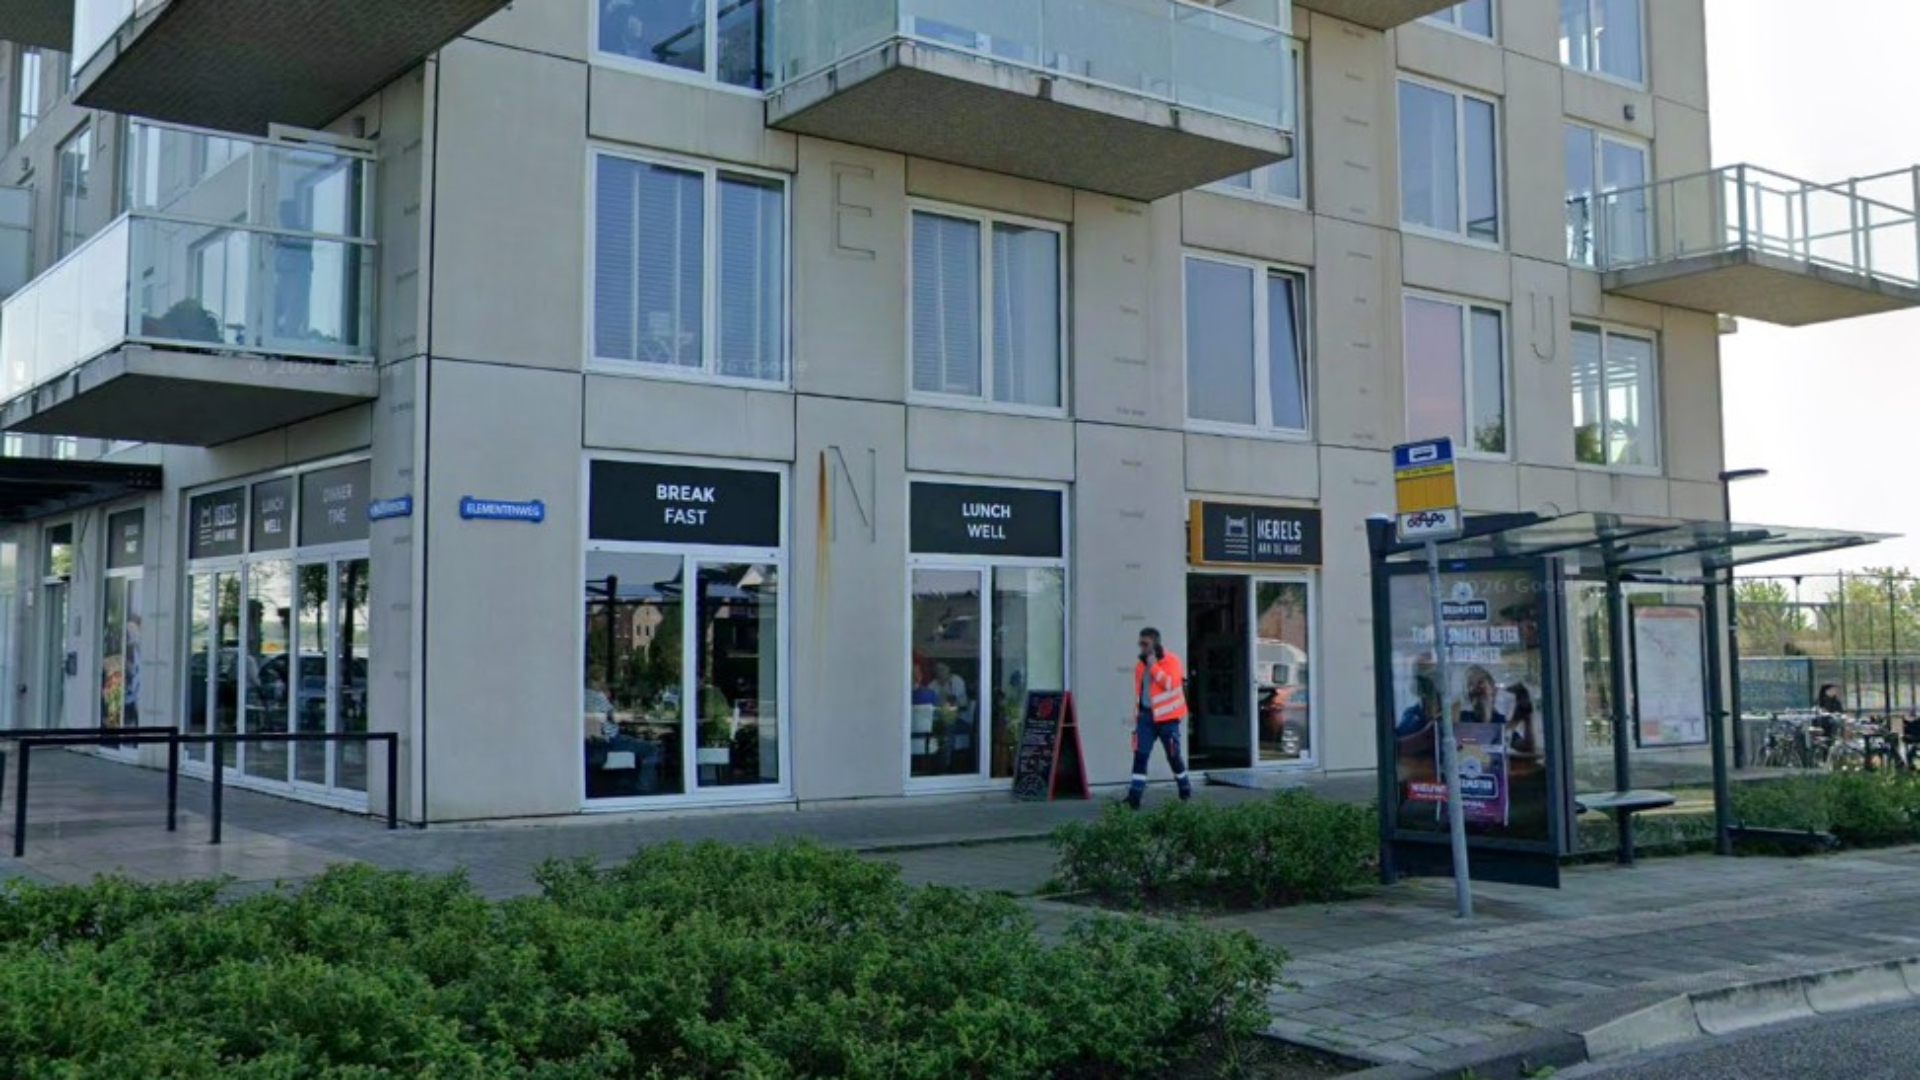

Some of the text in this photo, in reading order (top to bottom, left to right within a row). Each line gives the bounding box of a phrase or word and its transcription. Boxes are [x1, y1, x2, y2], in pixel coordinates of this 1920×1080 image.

[656, 484, 715, 502] BREAK
[466, 503, 540, 517] ELEMENTENWEG
[664, 507, 707, 525] FAST
[962, 503, 1011, 518] LUNCH
[967, 524, 1006, 539] WELL
[1257, 519, 1302, 541] KERELS
